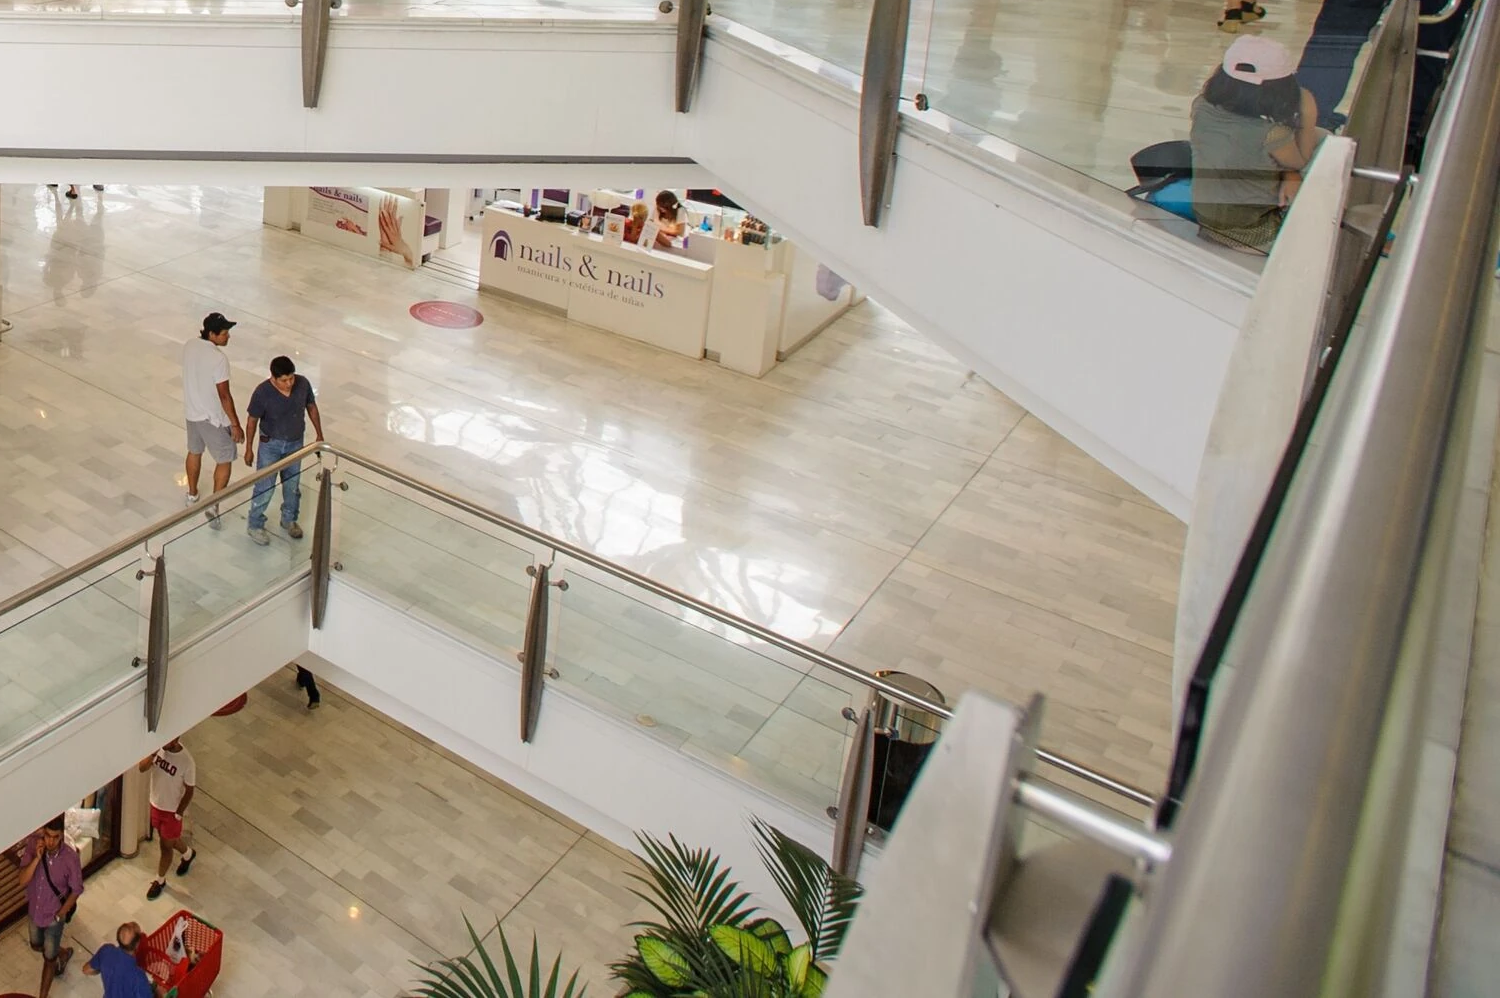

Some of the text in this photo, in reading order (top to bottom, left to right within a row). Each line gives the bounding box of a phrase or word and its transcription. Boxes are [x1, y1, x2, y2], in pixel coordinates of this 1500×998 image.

[343, 192, 363, 203] nails
[517, 264, 561, 283] manicura
[569, 280, 605, 295] estética
[606, 288, 619, 300] de
[621, 294, 645, 308] uñas
[519, 243, 665, 299] nails & nails
[155, 755, 177, 777] POLO
